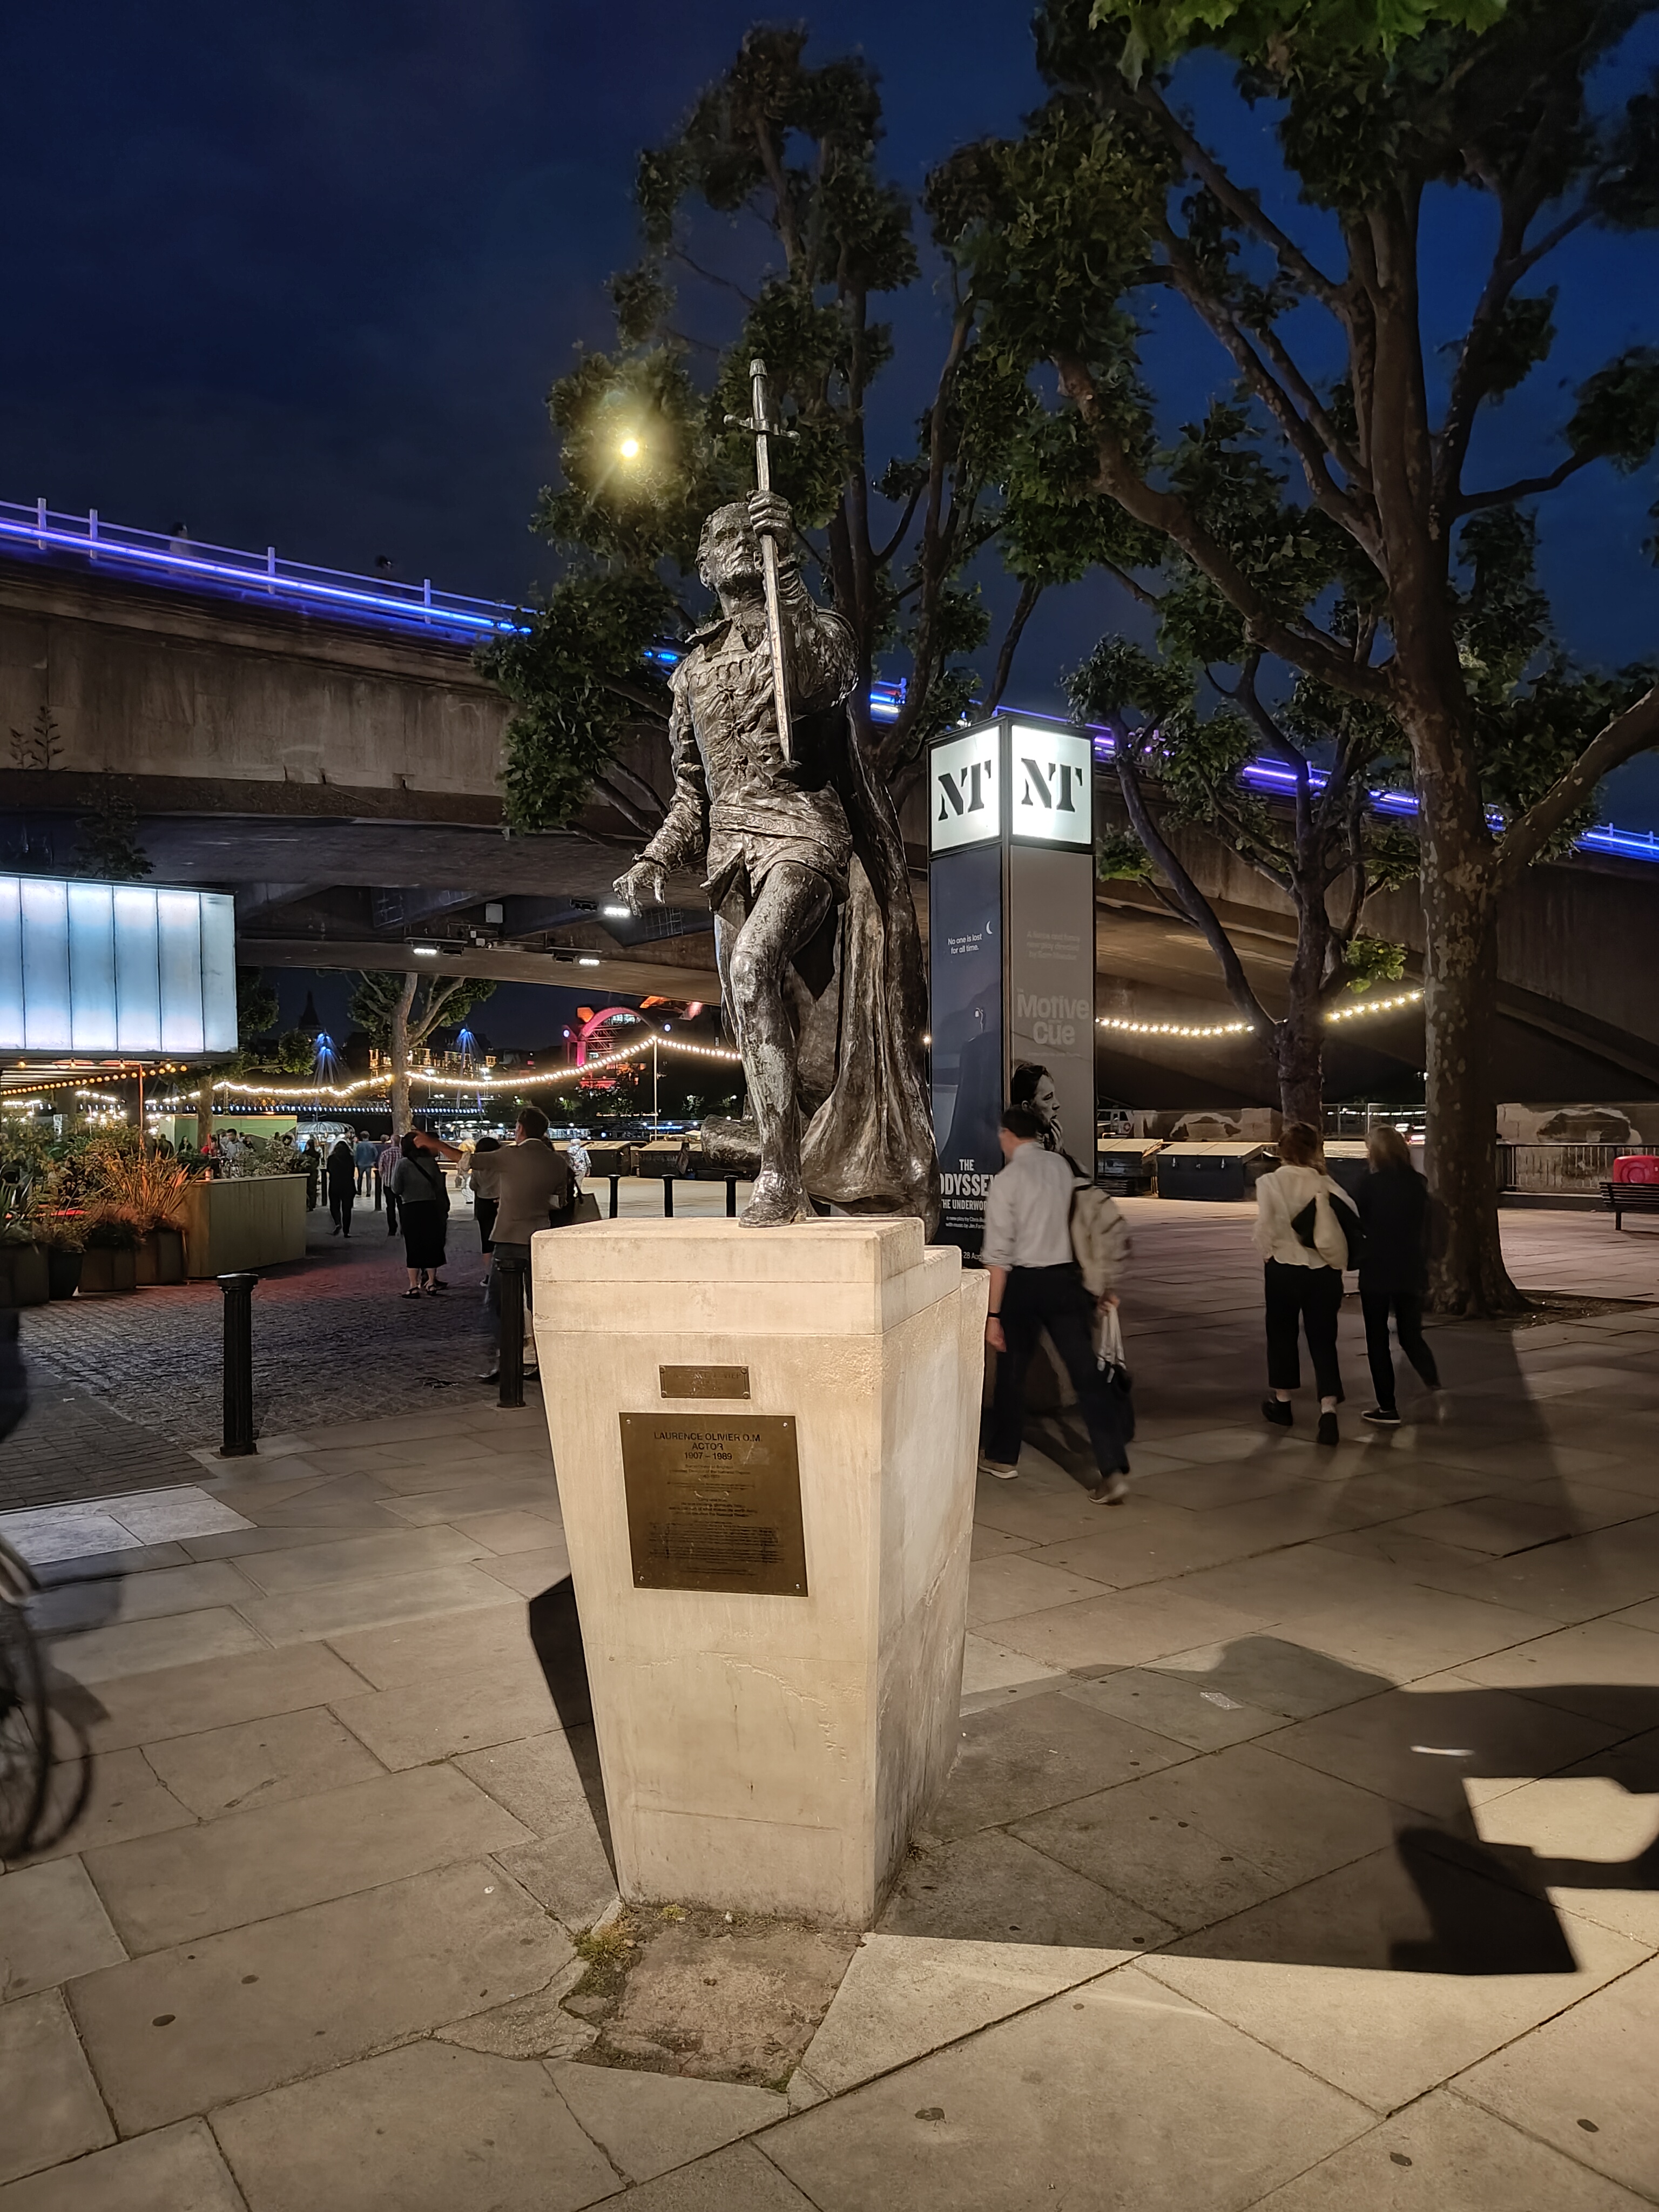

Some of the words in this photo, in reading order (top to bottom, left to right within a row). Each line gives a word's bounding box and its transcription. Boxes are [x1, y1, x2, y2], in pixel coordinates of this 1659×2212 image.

[938, 760, 991, 821] NT
[1021, 758, 1082, 813] NT
[972, 933, 982, 941] lost
[1017, 994, 1090, 1020] Motive
[1033, 1021, 1075, 1046] Cue
[959, 1159, 974, 1171] THE
[941, 1199, 950, 1209] HE
[971, 1252, 982, 1260] Aug
[654, 1432, 702, 1440] LAURENCE
[692, 1442, 724, 1451] ACTOR
[713, 1452, 732, 1460] 1989
